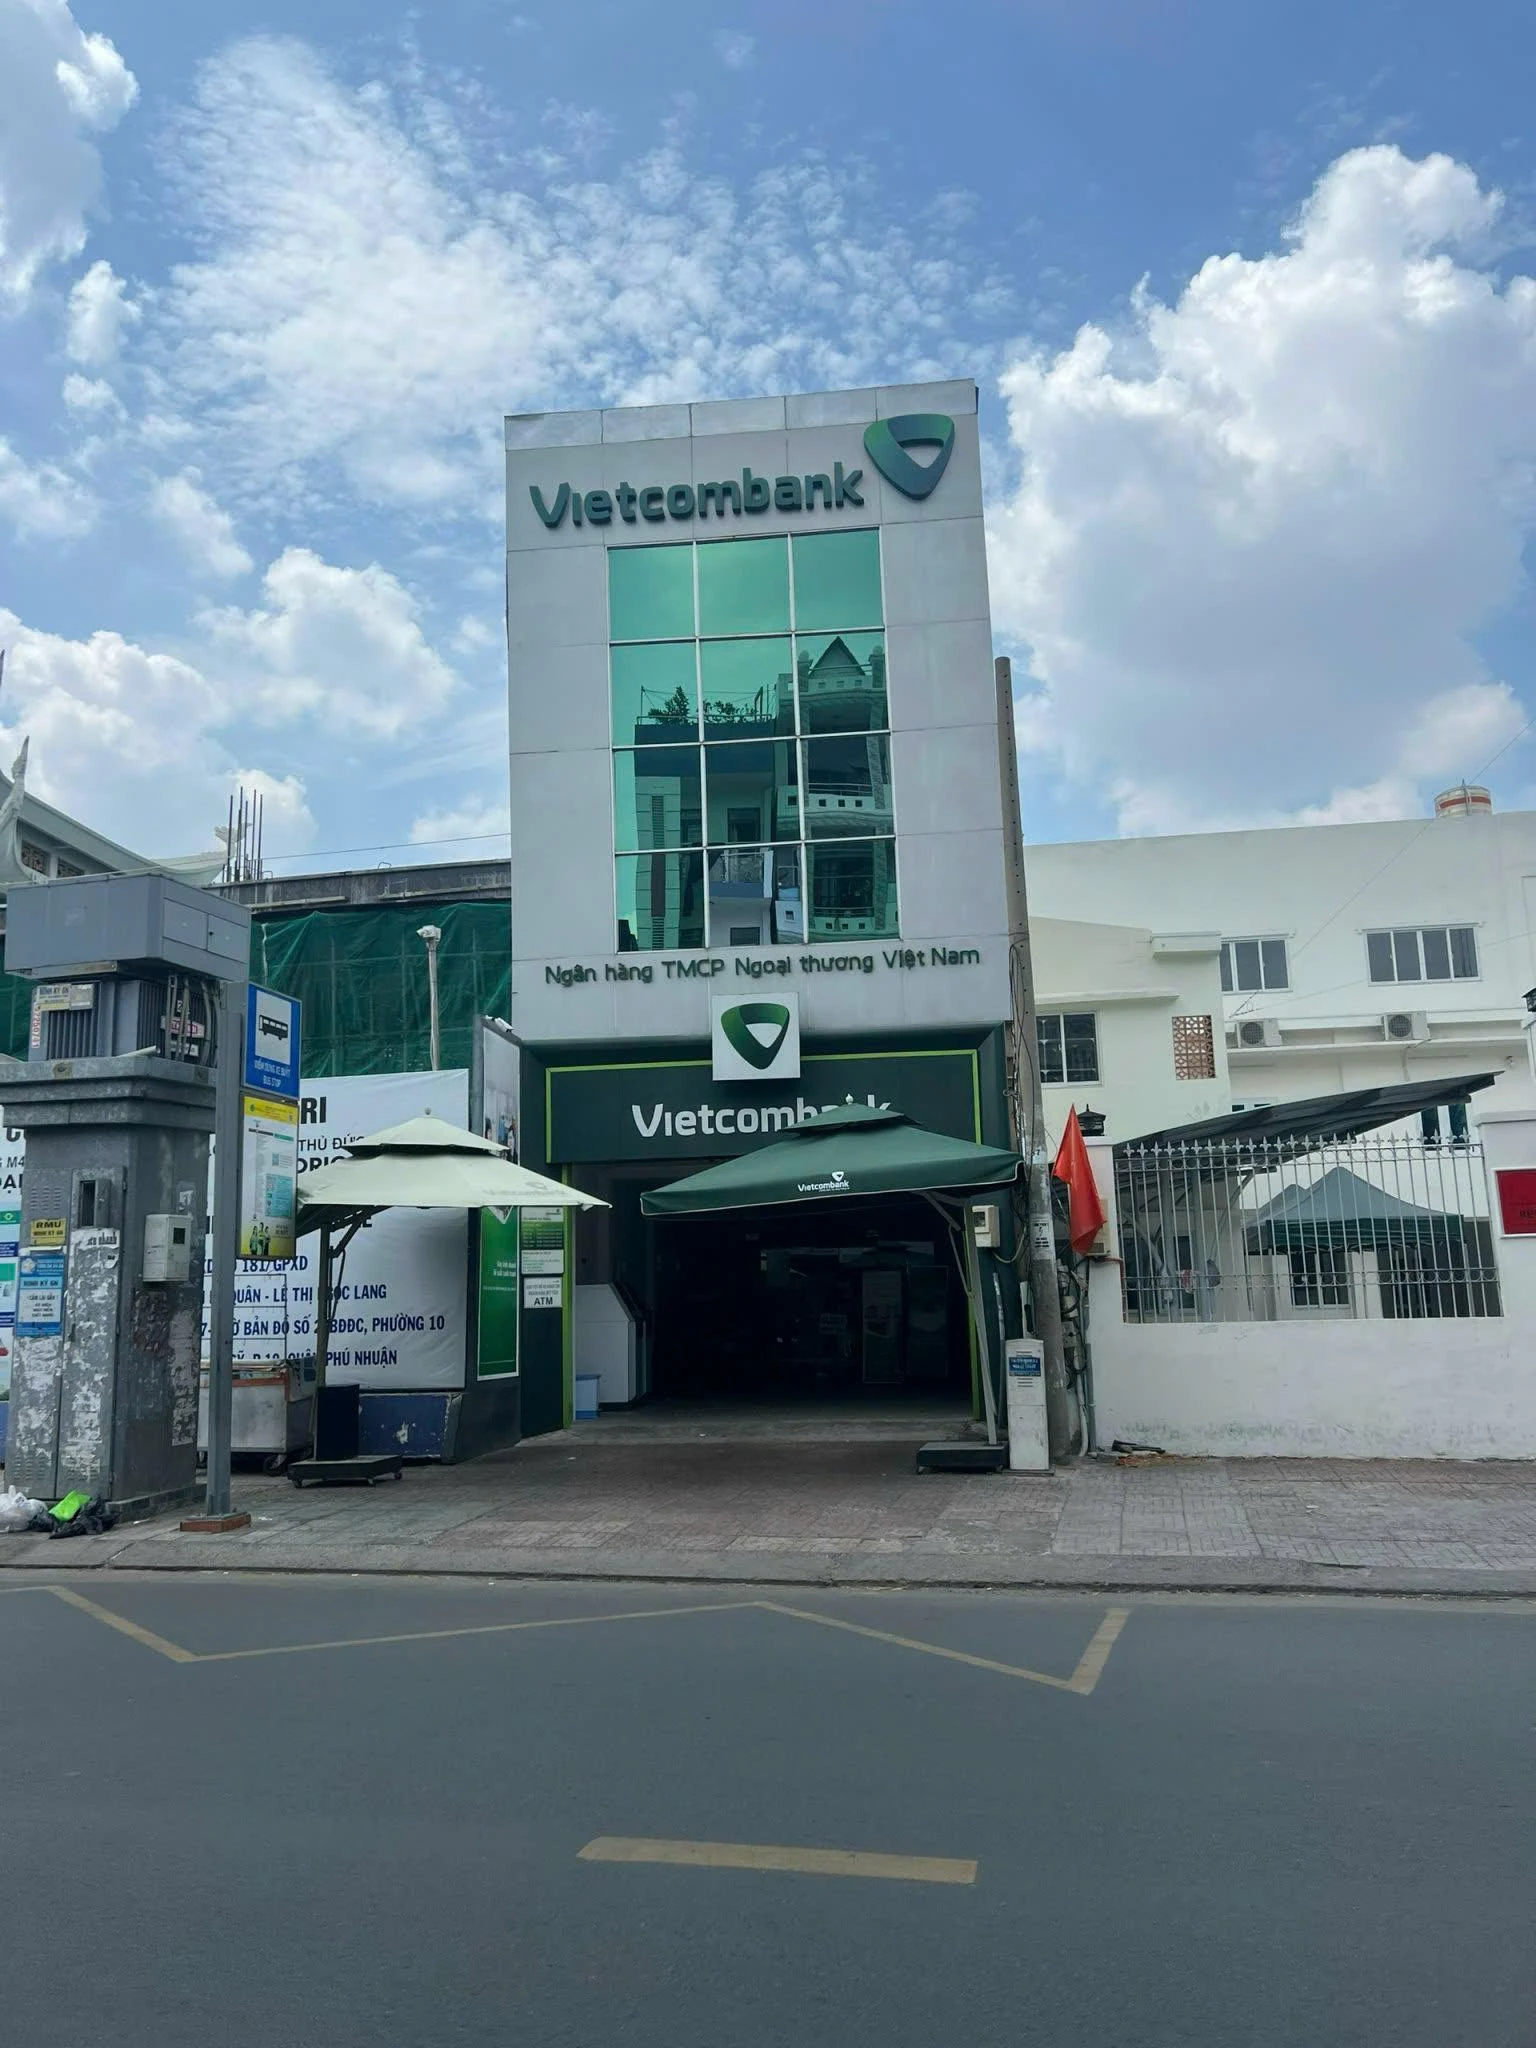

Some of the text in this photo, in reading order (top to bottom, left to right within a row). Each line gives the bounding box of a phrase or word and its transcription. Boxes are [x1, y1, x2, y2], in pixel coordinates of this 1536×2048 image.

[529, 461, 864, 528] Vietcombank
[545, 947, 980, 987] Ngân hàng TMCP Ngoại thương Việt Nam
[631, 1094, 891, 1138] Vietcomb
[298, 1134, 327, 1151] THỦ
[798, 1180, 850, 1192] Vietcombank
[293, 1287, 313, 1304] THỊ
[354, 1284, 387, 1300] LANG
[534, 1296, 554, 1306] ATM
[244, 1316, 269, 1335] BẢN
[294, 1313, 311, 1334] SỐ
[372, 1312, 424, 1331] PHƯỜNG
[429, 1315, 445, 1330] 10
[327, 1348, 350, 1366] PHÚ
[355, 1346, 397, 1368] NHUẬN
